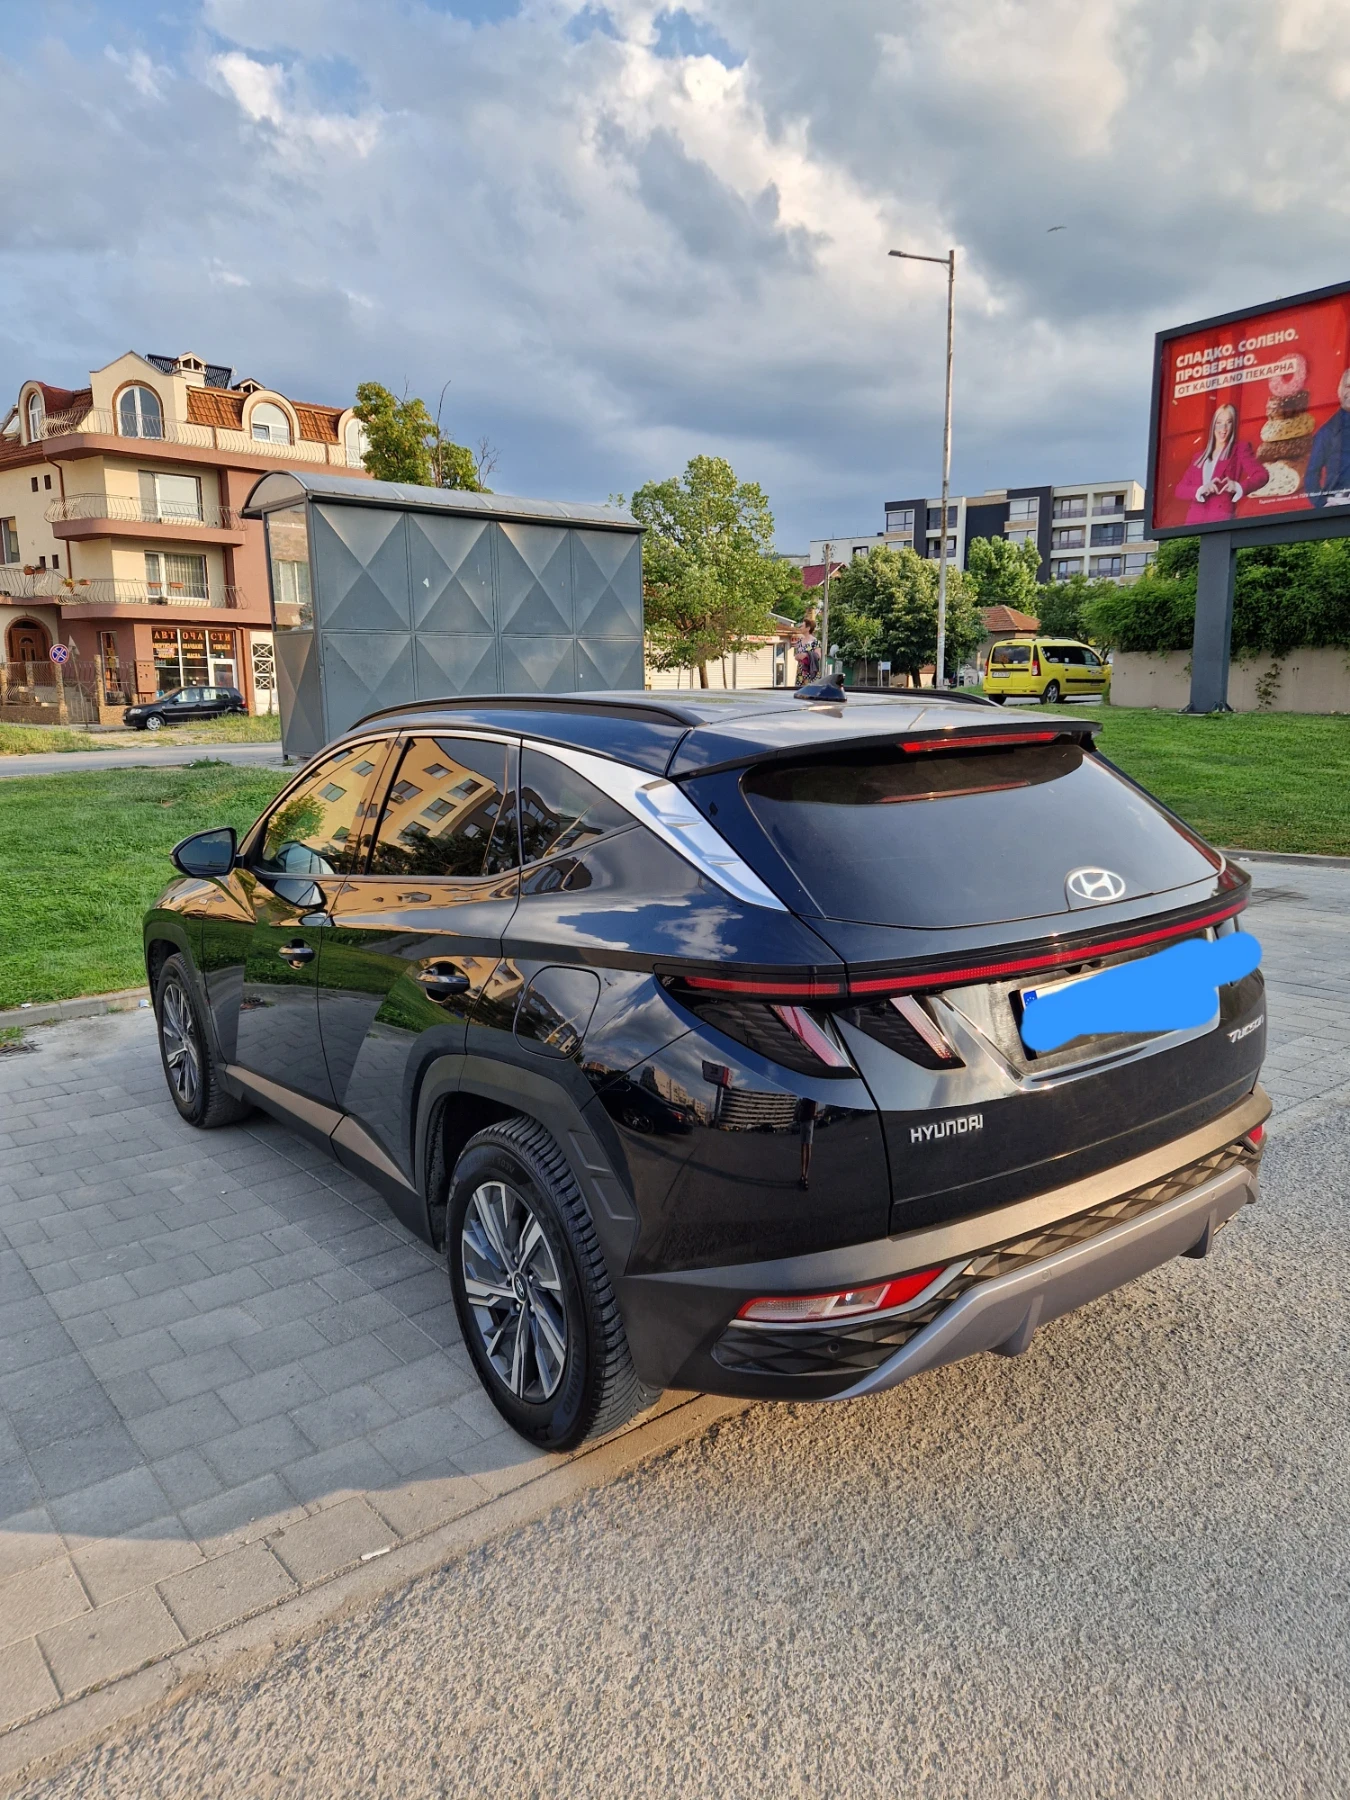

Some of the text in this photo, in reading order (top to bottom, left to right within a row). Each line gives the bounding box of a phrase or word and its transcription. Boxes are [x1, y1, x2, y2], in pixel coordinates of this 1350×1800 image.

[1176, 328, 1299, 367] СЛАДКО. СОЛЕНО.
[1175, 354, 1257, 383] ПРОВЕРЕНО.
[1178, 362, 1294, 394] ОТ KAUFLAND ПЕКАРНА
[910, 1114, 984, 1143] HYUNDAI
